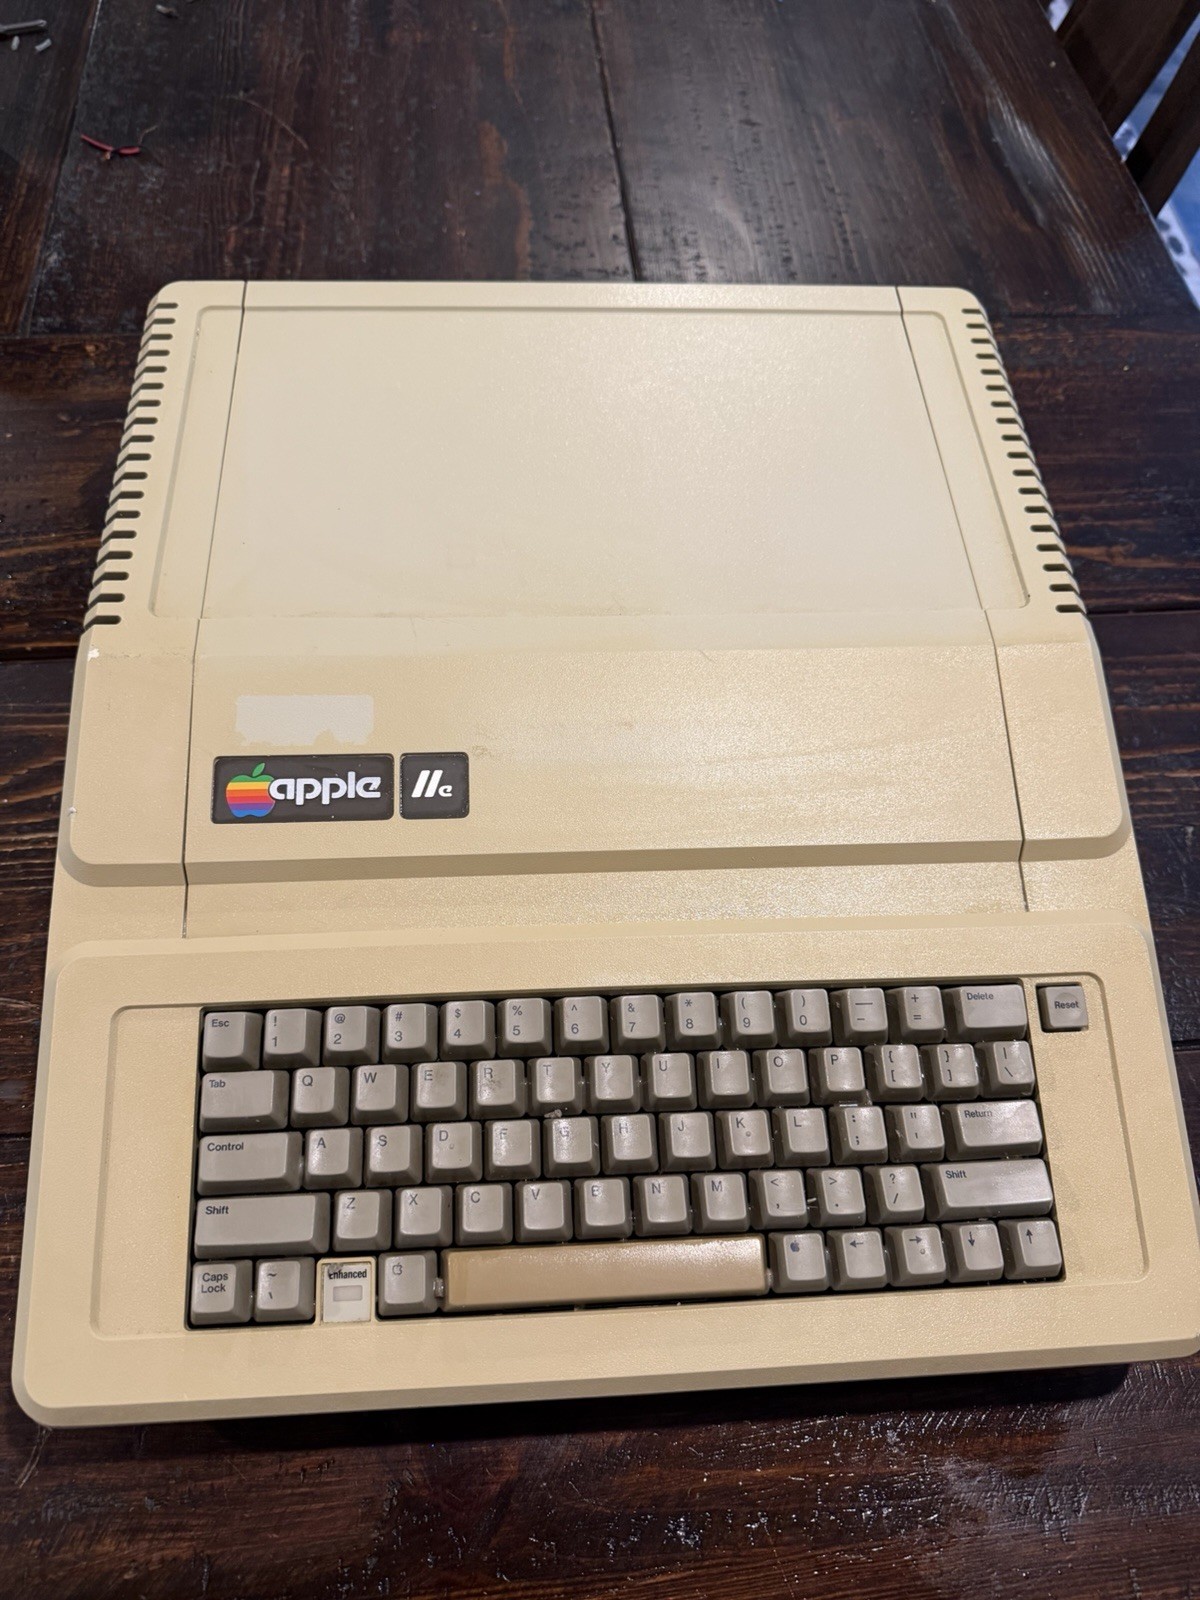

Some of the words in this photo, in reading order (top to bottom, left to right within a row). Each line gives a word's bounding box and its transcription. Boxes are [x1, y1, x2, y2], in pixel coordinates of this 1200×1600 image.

[269, 771, 382, 805] apple
[801, 995, 806, 1007] )
[911, 994, 920, 1002] +
[966, 992, 994, 1000] Delete
[627, 1003, 635, 1012] &
[741, 997, 746, 1010] (
[1054, 1001, 1080, 1009] Reset
[395, 1011, 403, 1021] #
[454, 1008, 462, 1019] $
[512, 1005, 523, 1016] %
[211, 1018, 230, 1028] Esc
[334, 1013, 346, 1024] @
[685, 1018, 694, 1029] 8
[742, 1017, 751, 1028] 9
[799, 1014, 807, 1026] 0
[512, 1025, 521, 1036] 5
[571, 1023, 580, 1034] 6
[628, 1021, 636, 1033] 7
[394, 1031, 403, 1042] 3
[453, 1028, 462, 1038] 4
[272, 1036, 278, 1047] 1
[333, 1033, 342, 1045] 2
[773, 1056, 784, 1068] O
[831, 1054, 839, 1065] P
[888, 1050, 894, 1063] {
[944, 1050, 950, 1063] }
[602, 1062, 611, 1073] Y
[659, 1060, 668, 1072] U
[716, 1058, 720, 1069] I
[424, 1069, 434, 1081] E
[483, 1067, 493, 1079] R
[543, 1064, 552, 1076] T
[948, 1069, 953, 1082] ]
[1004, 1066, 1013, 1078] \
[302, 1074, 314, 1087] Q
[363, 1072, 378, 1084] W
[891, 1070, 896, 1082] [
[209, 1079, 226, 1088] Tab
[851, 1115, 856, 1123] :
[964, 1110, 993, 1119] Return
[677, 1120, 685, 1131] J
[735, 1117, 746, 1129] K
[793, 1116, 802, 1127] L
[618, 1122, 628, 1134] H
[439, 1130, 449, 1141] D
[499, 1128, 508, 1140] F
[317, 1137, 326, 1149] A
[377, 1135, 388, 1147] S
[855, 1135, 860, 1145] ;
[207, 1142, 244, 1151] Control
[889, 1173, 896, 1184] ?
[945, 1170, 967, 1179] Shift
[711, 1180, 723, 1192] M
[770, 1178, 779, 1187] <
[828, 1176, 837, 1185] >
[591, 1185, 602, 1197] B
[651, 1182, 662, 1194] N
[408, 1193, 419, 1206] X
[470, 1191, 481, 1203] C
[531, 1188, 540, 1200] V
[893, 1192, 898, 1204] /
[346, 1197, 356, 1210] Z
[205, 1206, 229, 1215] Shift
[202, 1272, 229, 1282] Caps
[201, 1283, 226, 1294] Lock
